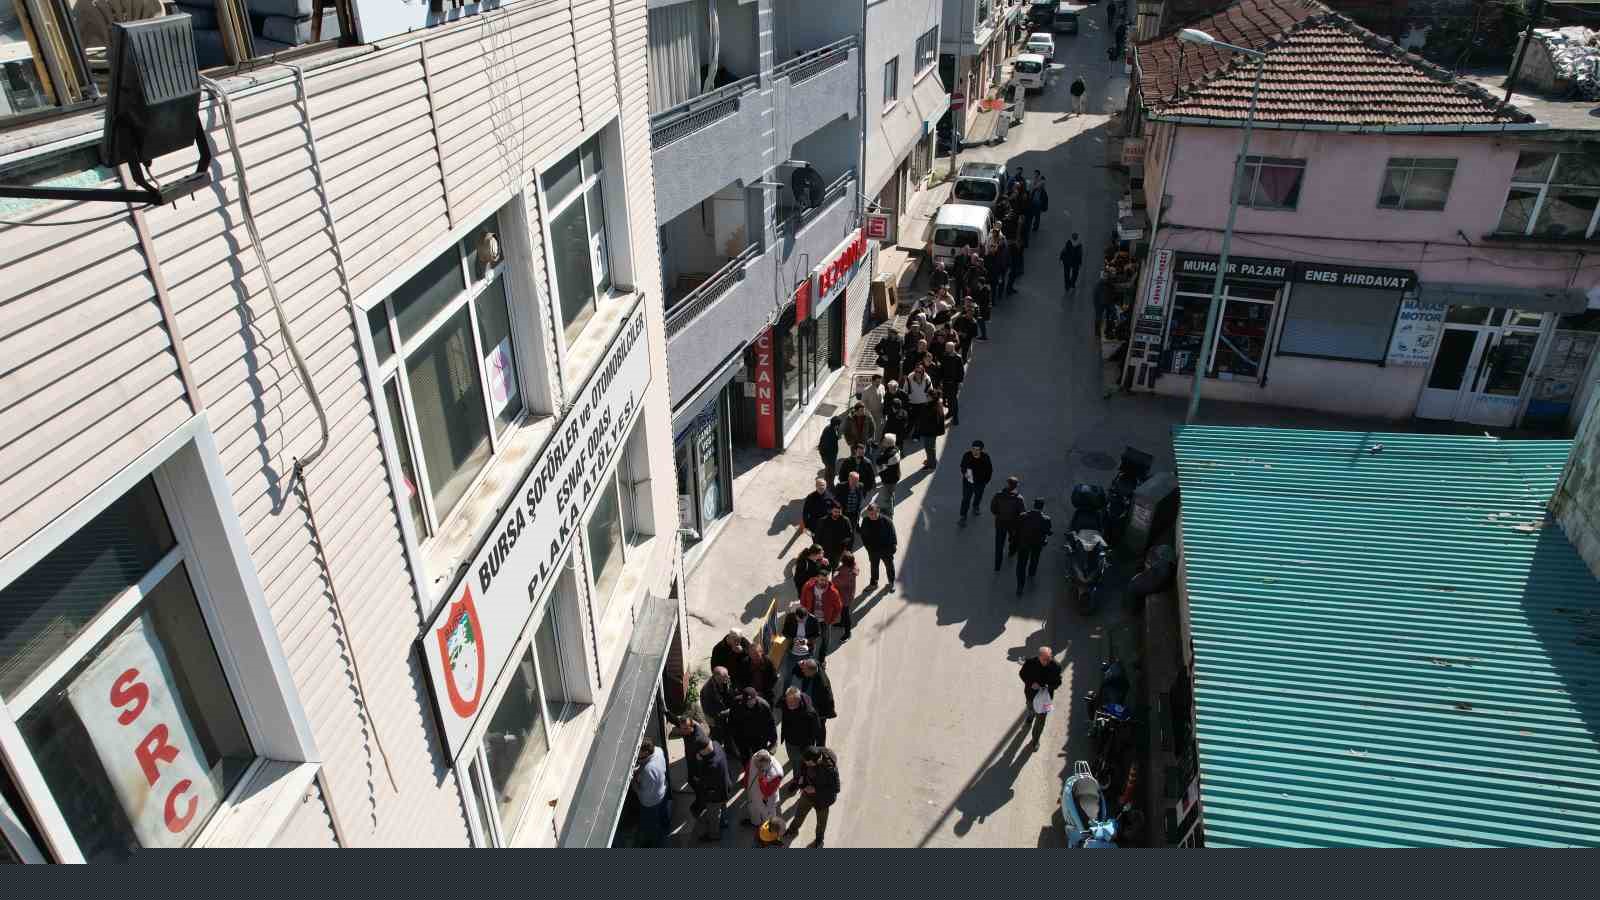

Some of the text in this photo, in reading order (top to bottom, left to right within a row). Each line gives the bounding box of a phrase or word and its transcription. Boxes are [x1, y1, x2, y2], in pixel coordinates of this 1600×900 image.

[1183, 260, 1285, 277] MUHAIR PAZARI
[1305, 270, 1408, 288] ENES HIRDAVAT
[1400, 312, 1442, 322] MOTOR
[757, 336, 771, 415] CZANE
[479, 507, 526, 595] BURSA
[526, 417, 580, 523] ŞOFÖRLER
[579, 403, 591, 434] ve
[528, 391, 635, 602] PLAKA ATÖLYESİ
[557, 404, 612, 515] ESNAF ODASI
[110, 667, 199, 834] SRC
